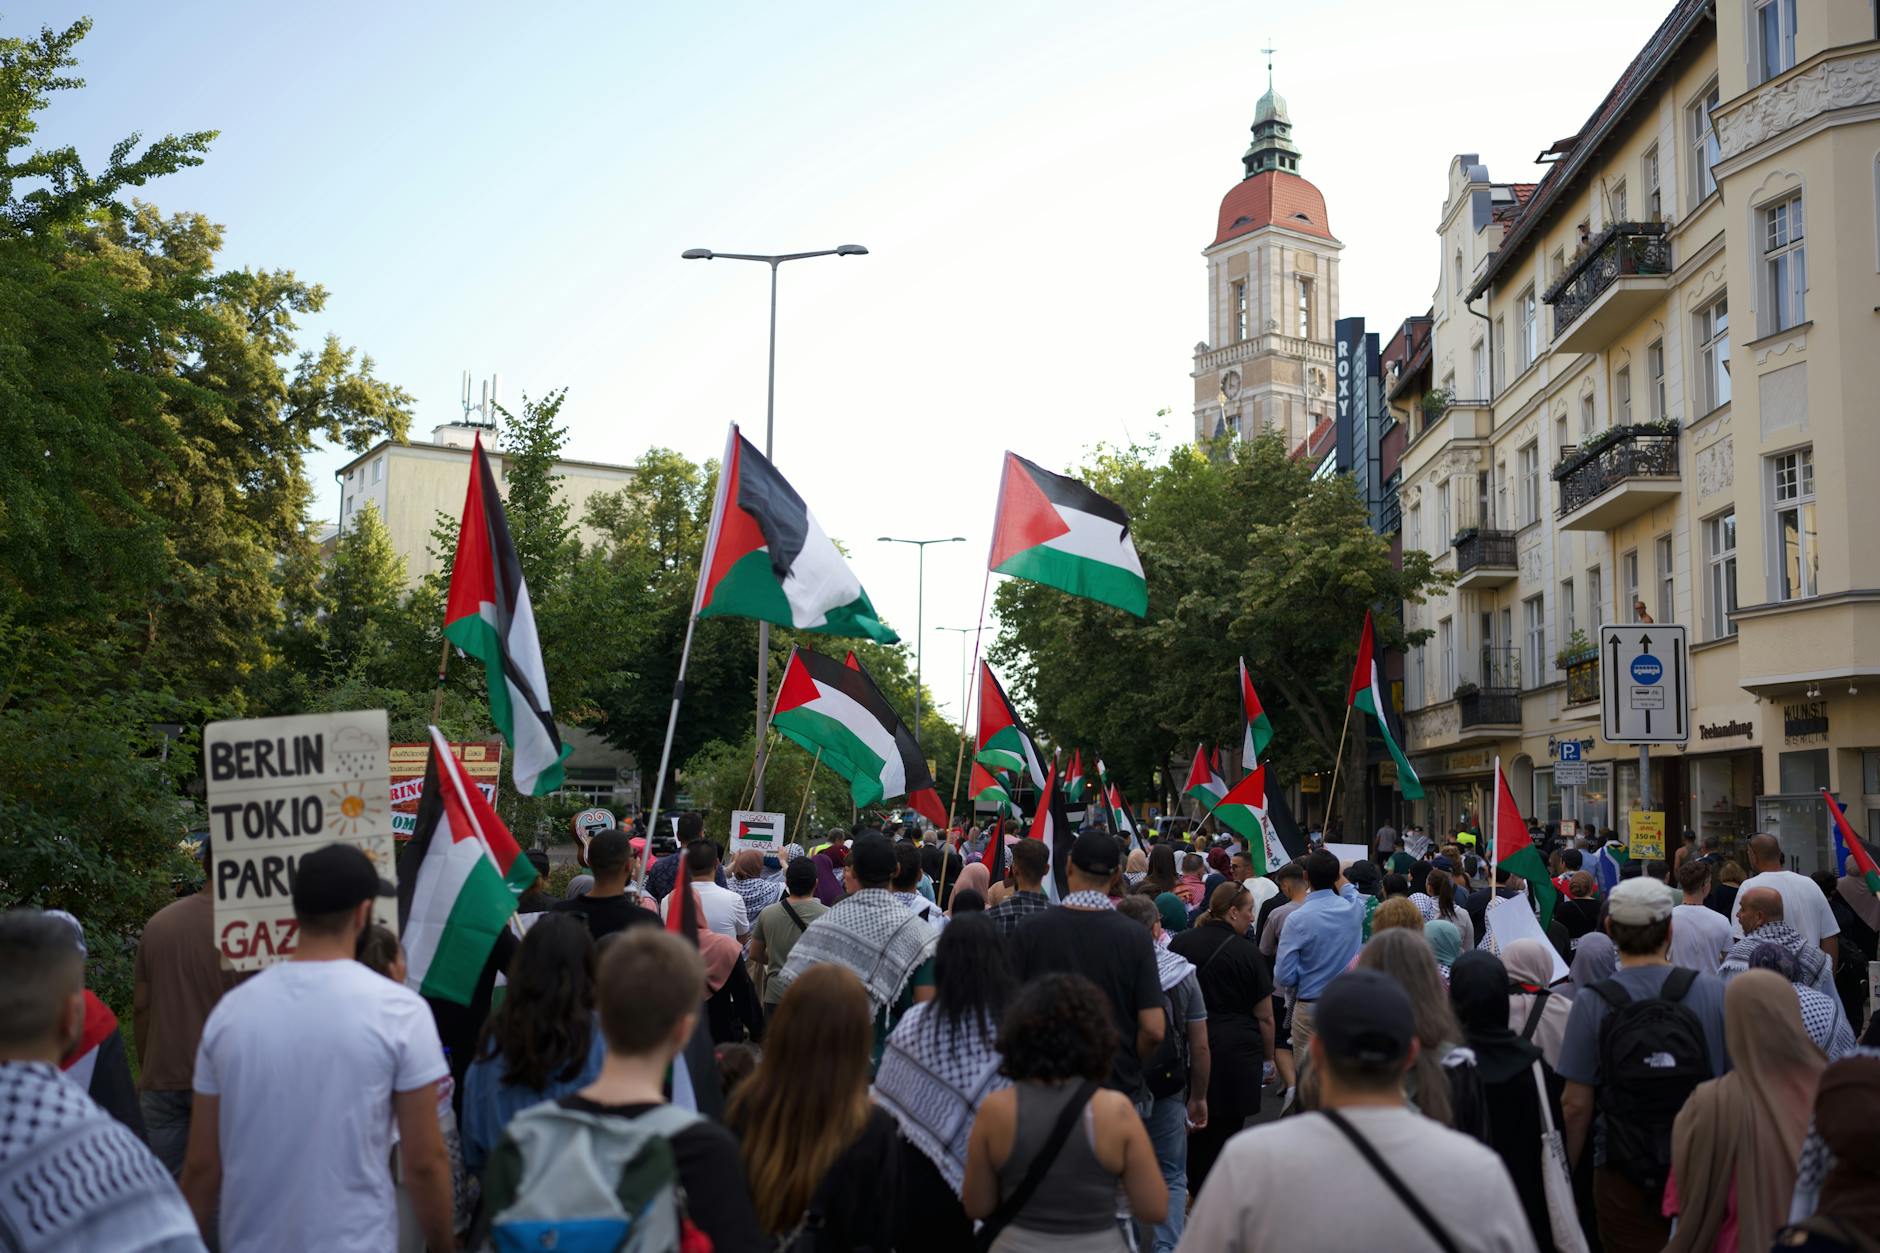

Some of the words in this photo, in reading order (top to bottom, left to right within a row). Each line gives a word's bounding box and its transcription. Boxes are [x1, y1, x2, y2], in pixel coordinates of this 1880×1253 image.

[1337, 340, 1349, 417] ROXY
[1699, 720, 1753, 740] Teehandlung
[1784, 701, 1827, 720] KUNST
[210, 734, 324, 782] BERLIN
[1563, 743, 1575, 760] P
[211, 795, 323, 842] TOKIO
[751, 841, 773, 849] GAZA
[218, 854, 300, 901] PARI
[221, 917, 300, 959] GAZ
